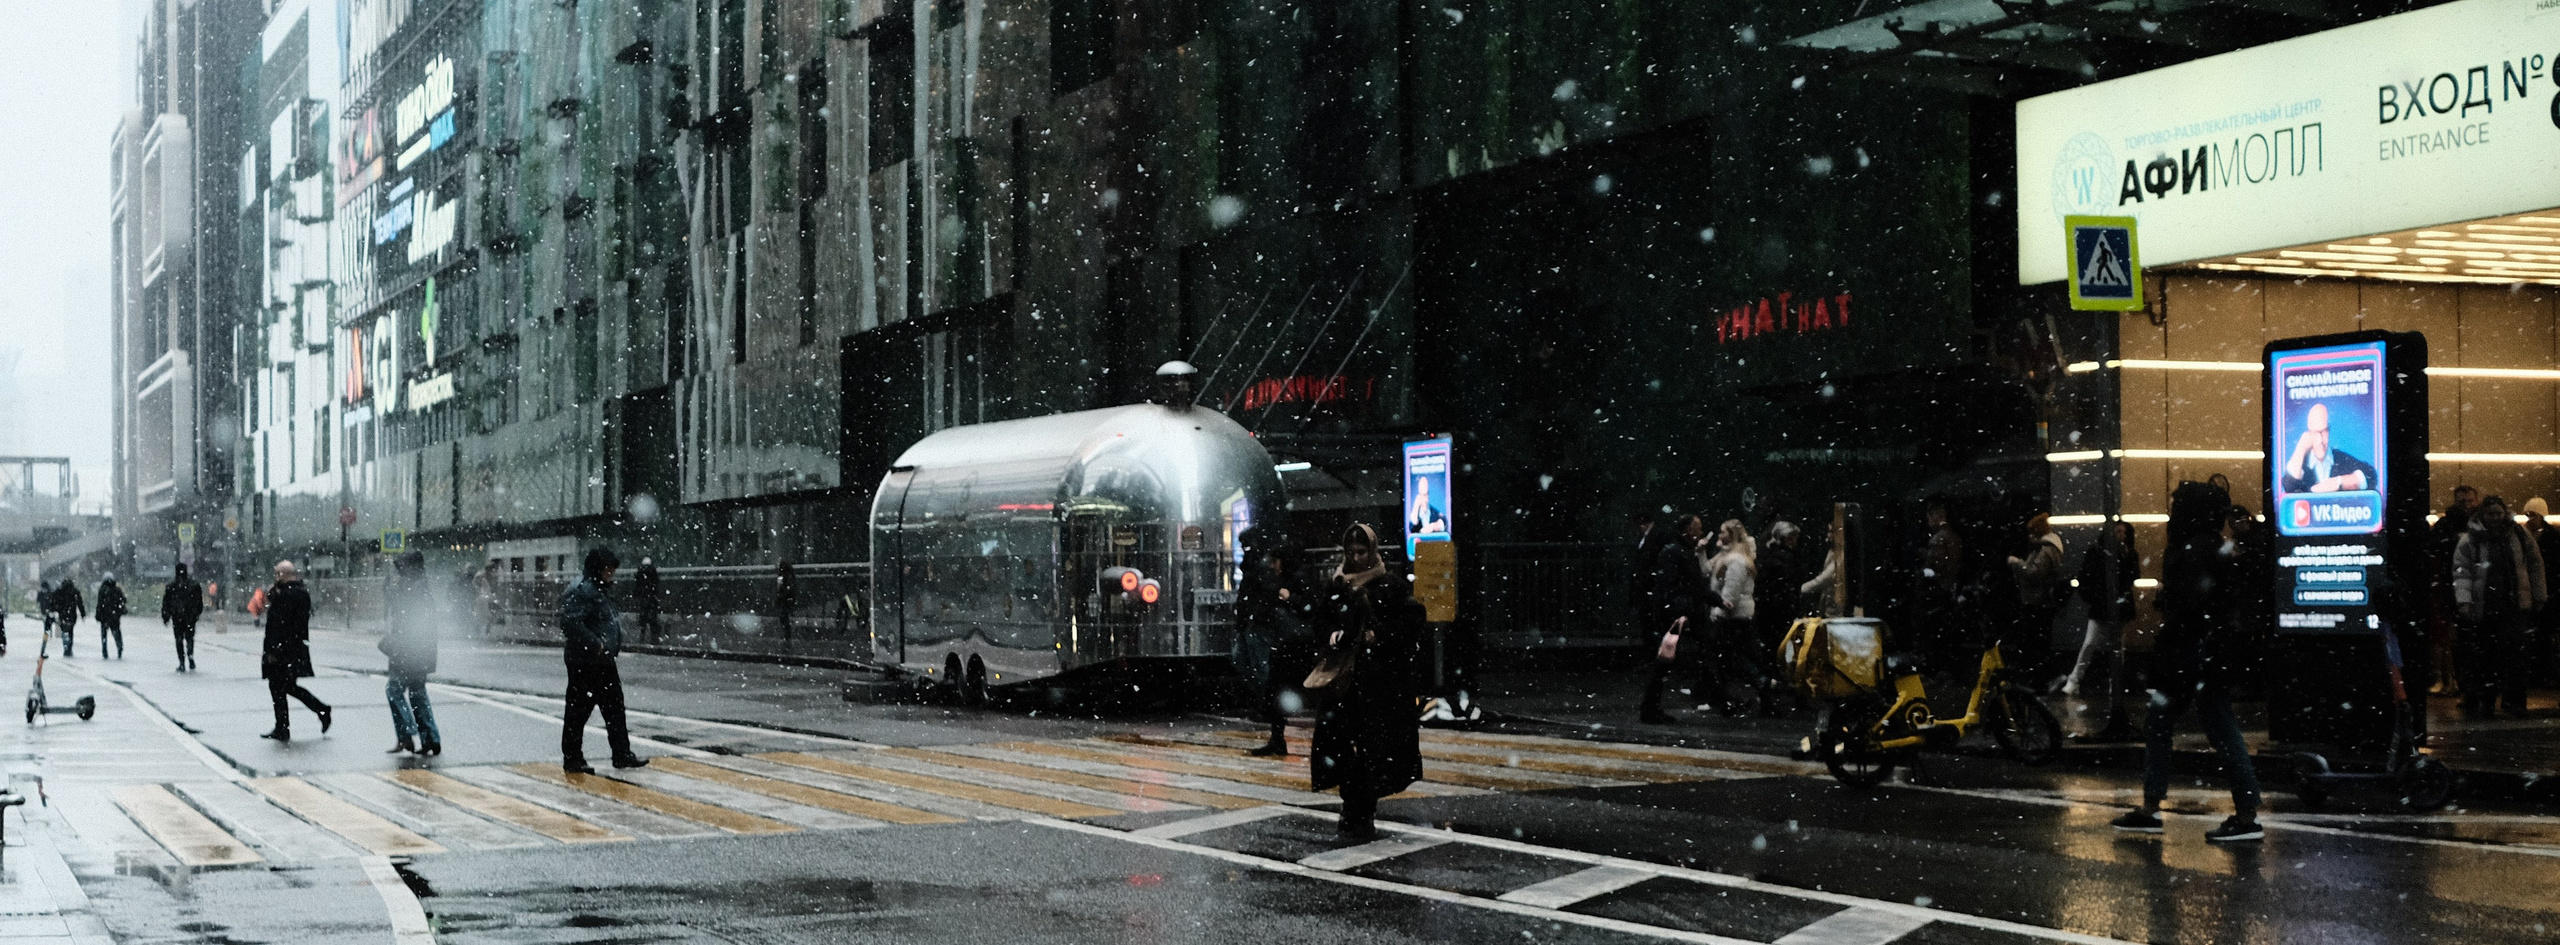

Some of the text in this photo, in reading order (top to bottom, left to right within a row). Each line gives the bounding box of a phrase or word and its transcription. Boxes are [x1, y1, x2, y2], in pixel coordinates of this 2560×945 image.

[2379, 64, 2493, 125] ВХОД
[2124, 98, 2322, 149] ТОРГОВО-РАЗВЛЕКАТЕЛЬНЫЙ ЦЕНТР
[2379, 121, 2491, 161] ENTRANCE
[2119, 121, 2323, 206] АФИМОЛЛ
[2286, 368, 2372, 388] СКАЧАЙ НОВОЕ
[2290, 382, 2369, 400] ПРИЛОЖЕНИЕ
[2313, 503, 2372, 524] VK Видео
